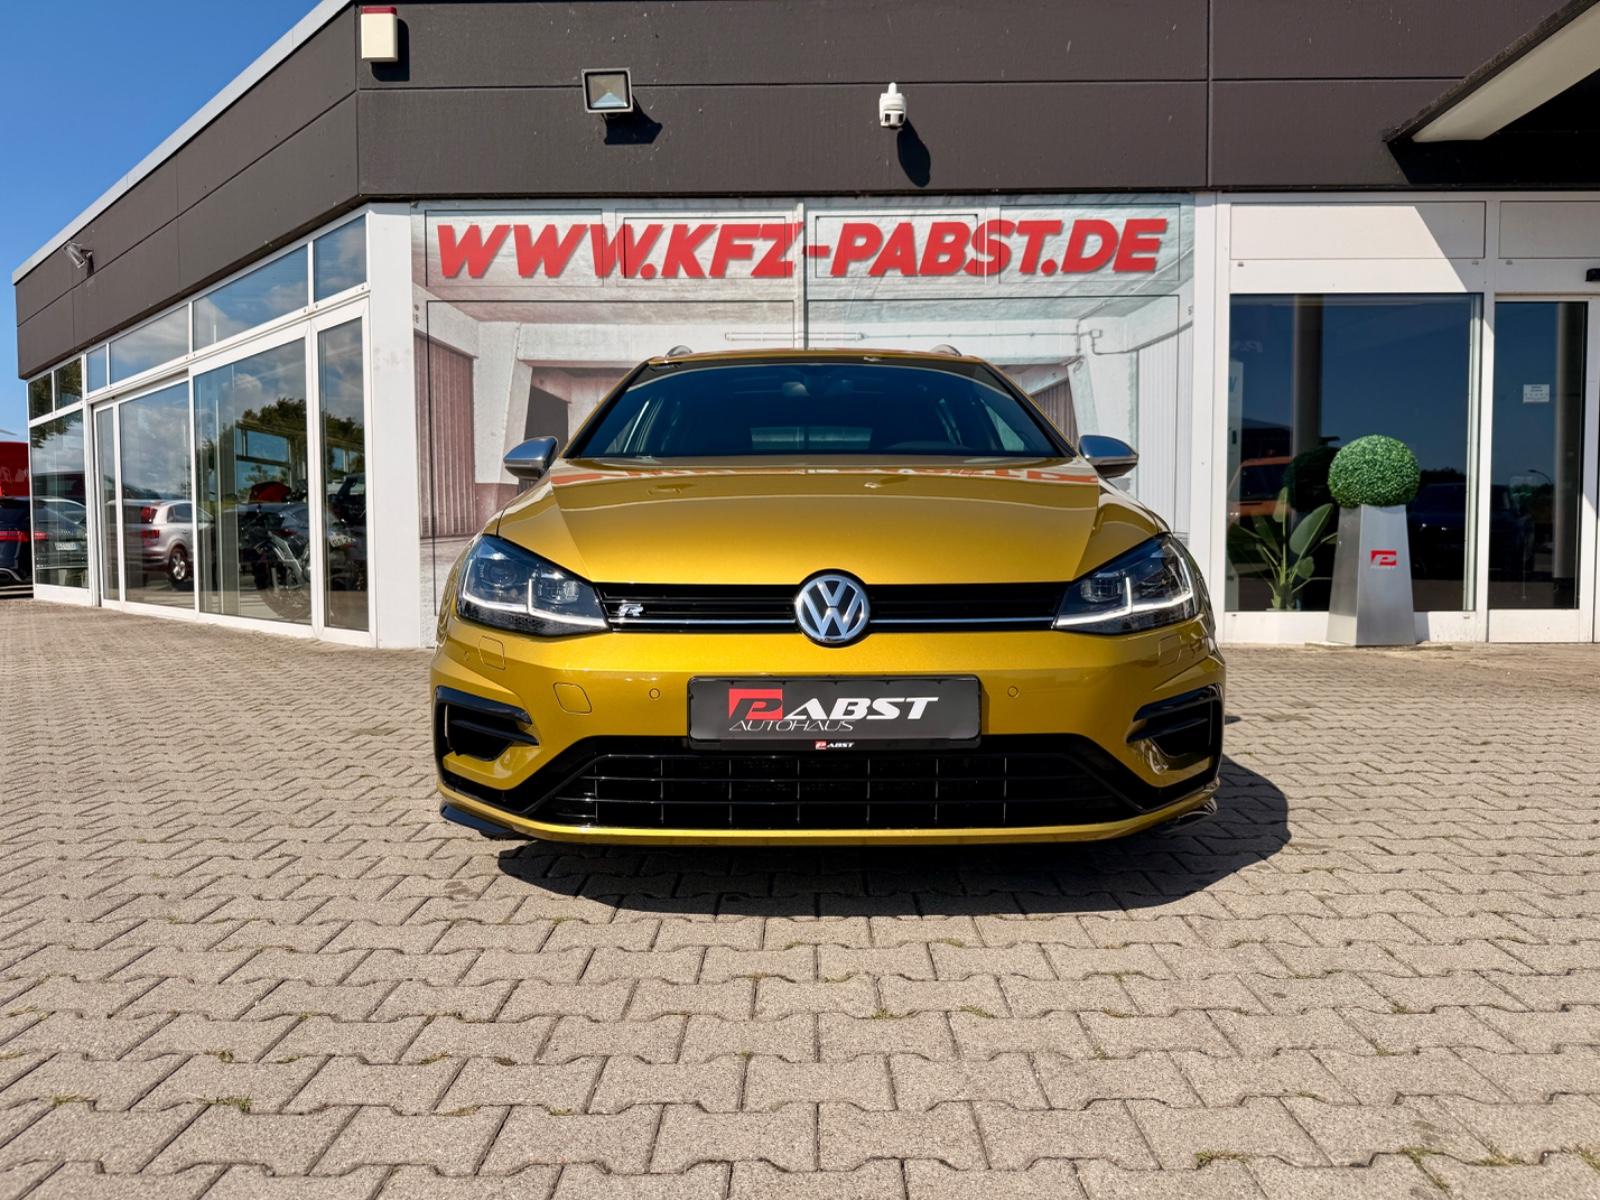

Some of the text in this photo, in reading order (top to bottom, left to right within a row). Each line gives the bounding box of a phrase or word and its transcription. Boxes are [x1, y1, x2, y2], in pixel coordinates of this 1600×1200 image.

[437, 217, 1168, 279] WWW.KFZ-PABST.DE
[729, 689, 940, 720] PABST
[729, 719, 855, 732] AUTOHAUS
